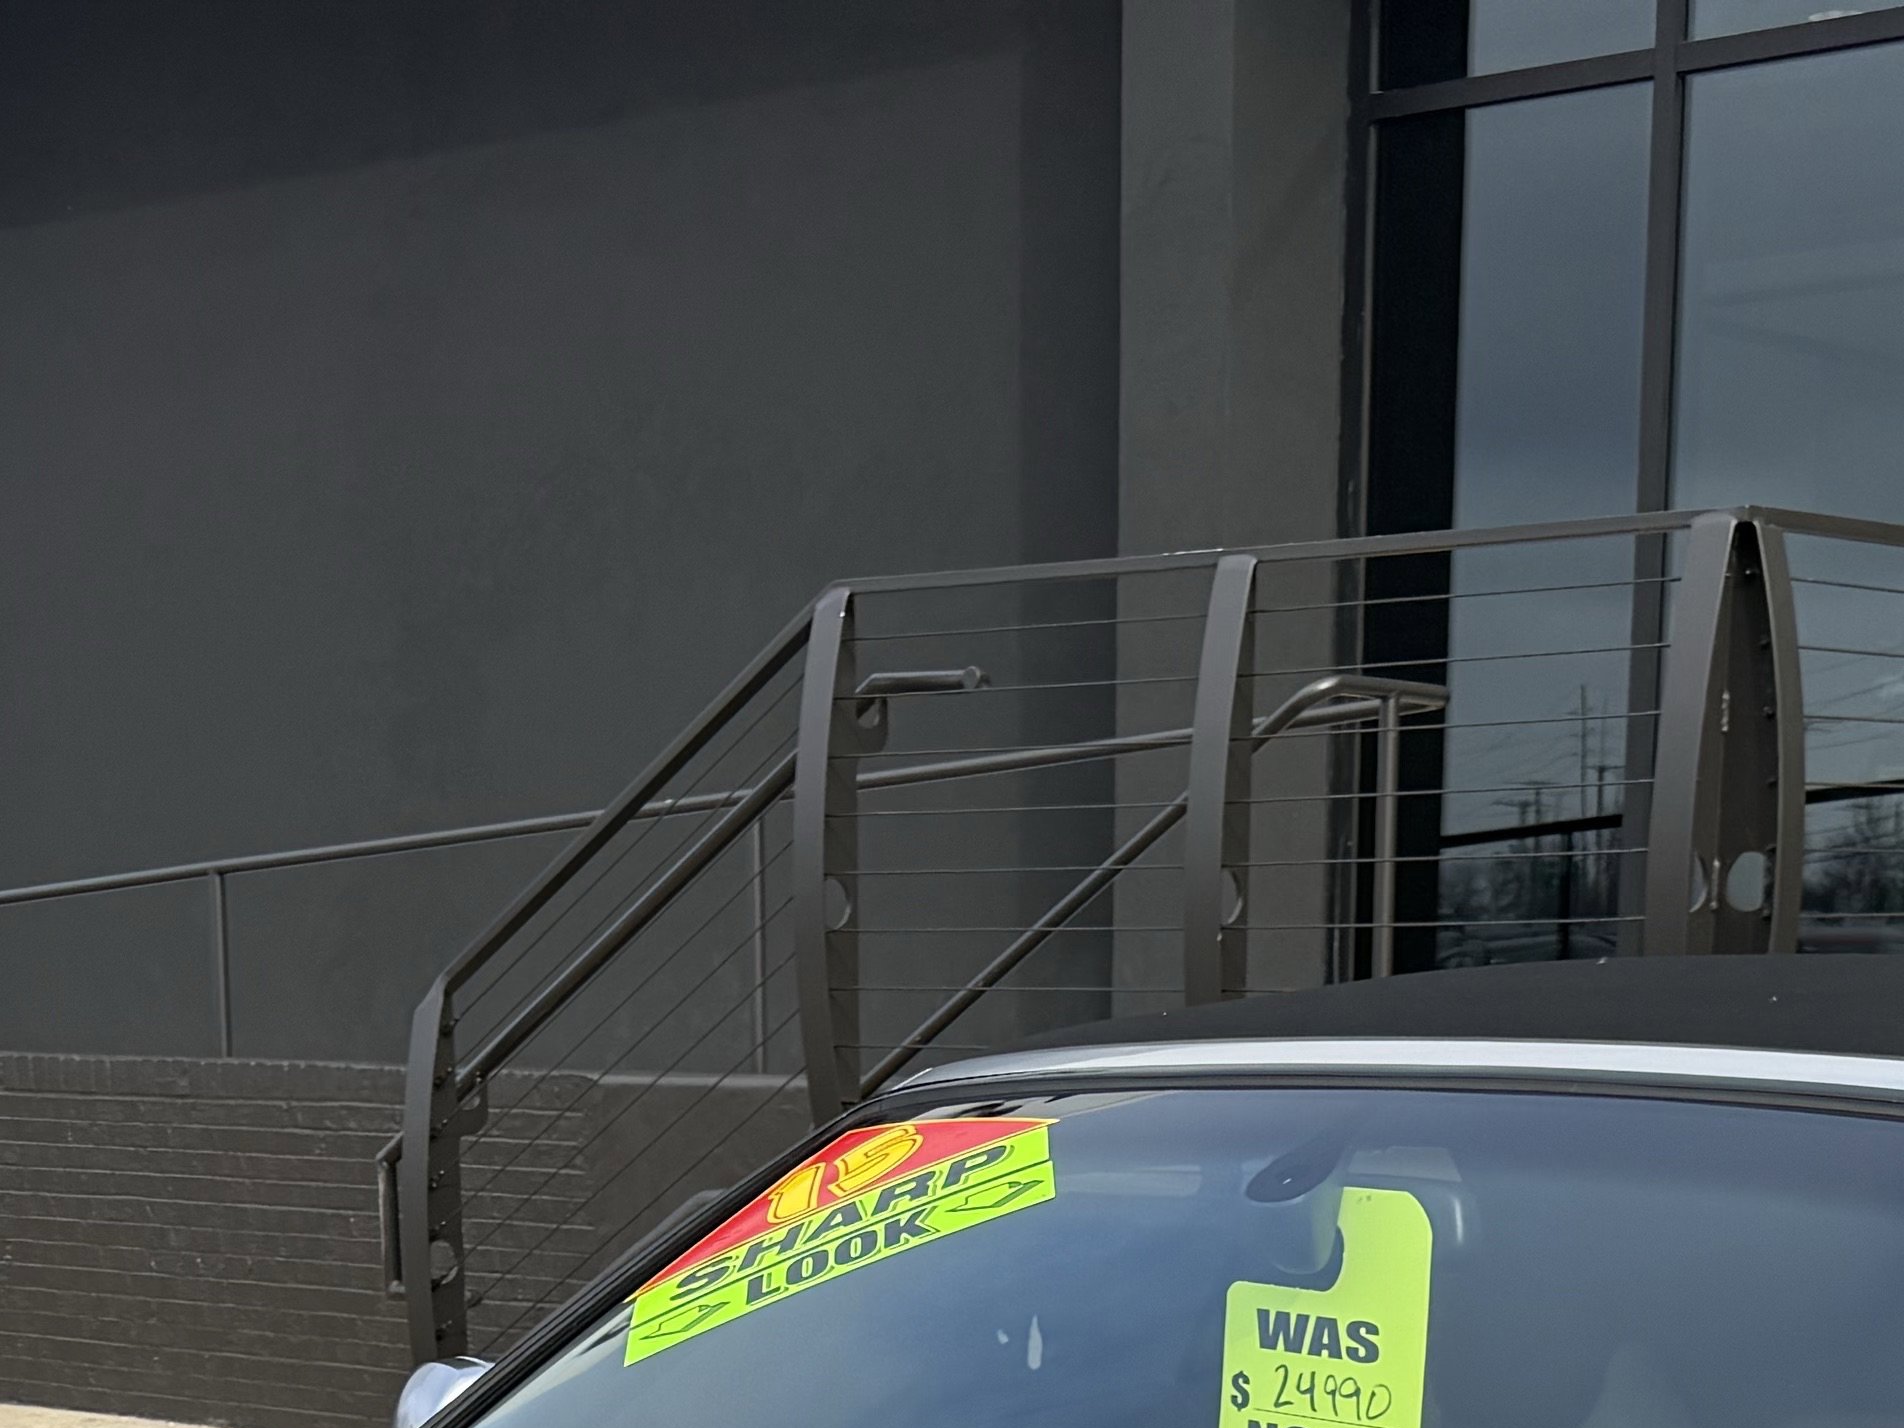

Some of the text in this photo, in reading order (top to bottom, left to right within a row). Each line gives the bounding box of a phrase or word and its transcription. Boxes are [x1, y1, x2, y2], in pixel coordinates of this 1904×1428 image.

[670, 1145, 1014, 1300] SHARP
[767, 1125, 924, 1223] 15
[746, 1205, 940, 1305] LOOK
[1257, 1308, 1379, 1364] WAS
[1231, 1364, 1392, 1421] $ 24990
